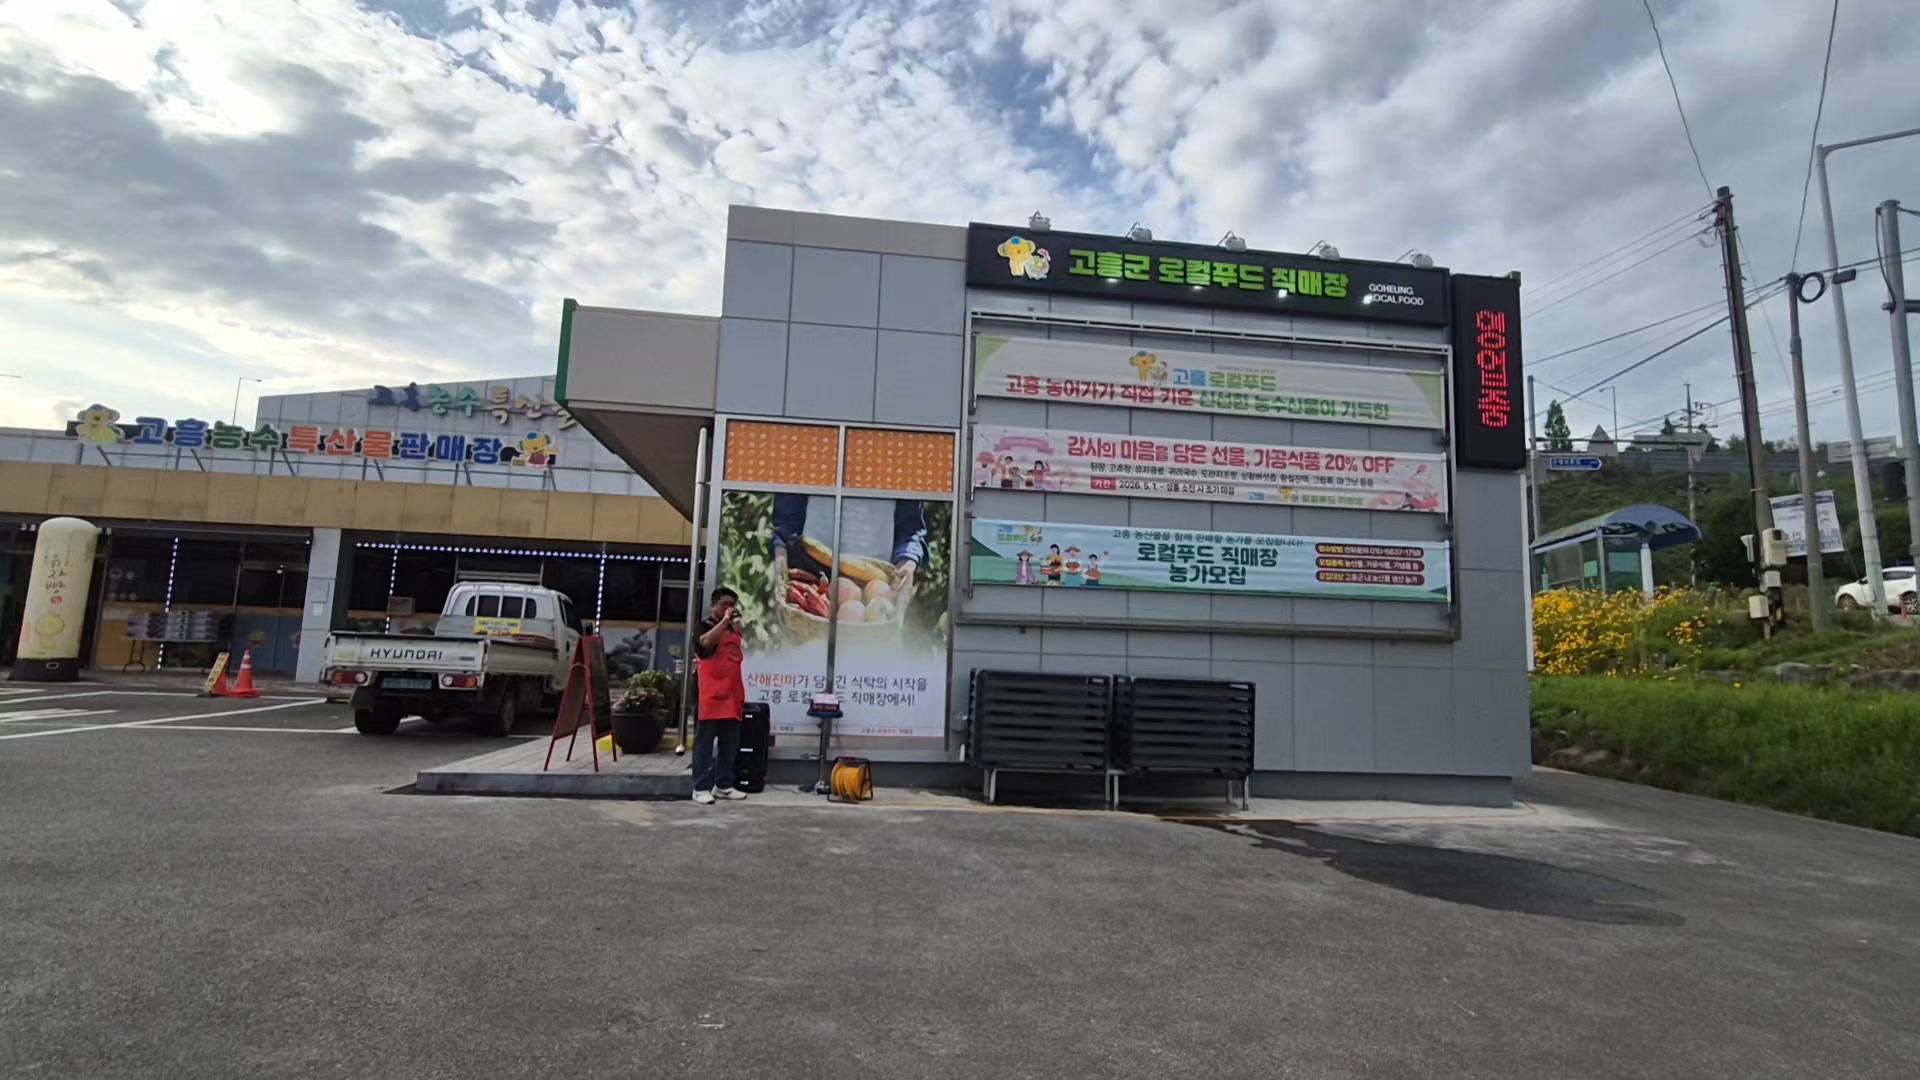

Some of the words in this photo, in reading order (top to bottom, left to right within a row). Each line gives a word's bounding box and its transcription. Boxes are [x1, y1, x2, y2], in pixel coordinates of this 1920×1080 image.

[1069, 249, 1150, 281] 고흥군
[1159, 257, 1264, 291] 로컬푸드
[1272, 267, 1349, 298] 직매장
[1368, 283, 1414, 295] GOHEUNG
[1398, 296, 1425, 306] FOOD
[1173, 368, 1206, 387] 고흥
[1209, 371, 1277, 392] 로컬푸드
[1006, 374, 1040, 396] 고흥
[1046, 378, 1114, 400] 농어가가
[1120, 384, 1156, 404] 직접
[1160, 387, 1193, 406] 키운
[1200, 390, 1249, 410] 신선한
[1254, 395, 1336, 417] 농수산물이
[1067, 436, 1116, 459] 감사의
[1120, 440, 1169, 462] 마음을
[1173, 443, 1208, 465] 담은
[1212, 445, 1250, 468] 선물,
[1254, 448, 1321, 471] 가공식품
[1325, 454, 1358, 472] 20%
[1362, 455, 1396, 473] OFF
[1094, 480, 1112, 489] 기간
[1119, 480, 1142, 490] 2026.
[1166, 484, 1180, 493] 상품
[1182, 484, 1196, 493] 소진
[1112, 529, 1131, 539] 고흥
[1137, 542, 1215, 564] 로컬푸드
[1221, 545, 1279, 568] 직매장
[1169, 564, 1247, 586] 농가모집
[370, 648, 443, 661] HYUNDAI
[747, 673, 809, 689] 산해진미가
[852, 675, 887, 690] 식탁의
[892, 677, 928, 691] 시작을
[758, 690, 784, 704] 고흥
[788, 690, 849, 704] 로컬드
[851, 691, 916, 708] 직매장에서!
